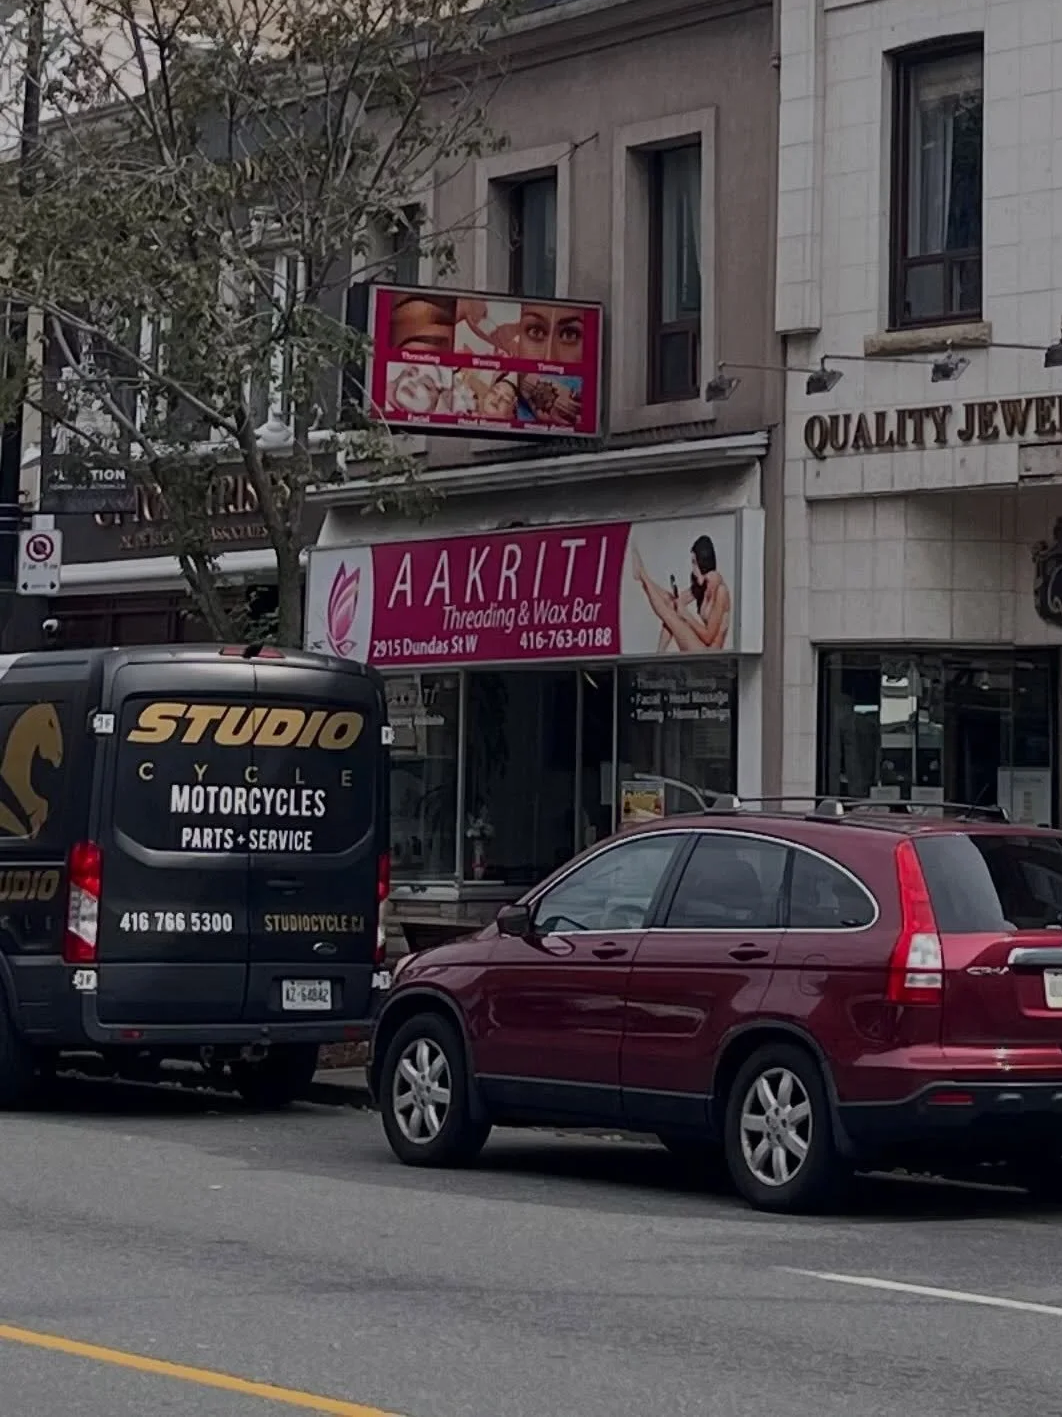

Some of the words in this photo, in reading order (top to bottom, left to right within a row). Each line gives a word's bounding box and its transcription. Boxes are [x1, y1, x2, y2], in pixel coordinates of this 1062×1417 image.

[803, 404, 953, 460] QUALITY
[387, 536, 608, 609] AAKRITI
[442, 602, 515, 633] Threading
[517, 600, 530, 627] &
[533, 598, 569, 625] Wax
[572, 597, 602, 623] Bar
[372, 638, 401, 658] 2915
[403, 636, 449, 656] Dundas
[451, 635, 464, 654] St
[464, 634, 479, 654] W
[519, 628, 613, 650] 416-763-0188
[127, 702, 365, 750] STUDIO
[138, 762, 353, 787] CYCLE
[170, 784, 326, 818] MOTORCYCLES
[181, 827, 234, 850] PARTS
[249, 829, 313, 851] SERVICE
[120, 912, 149, 932] 416
[154, 912, 186, 932] 766
[190, 912, 234, 932] 5300
